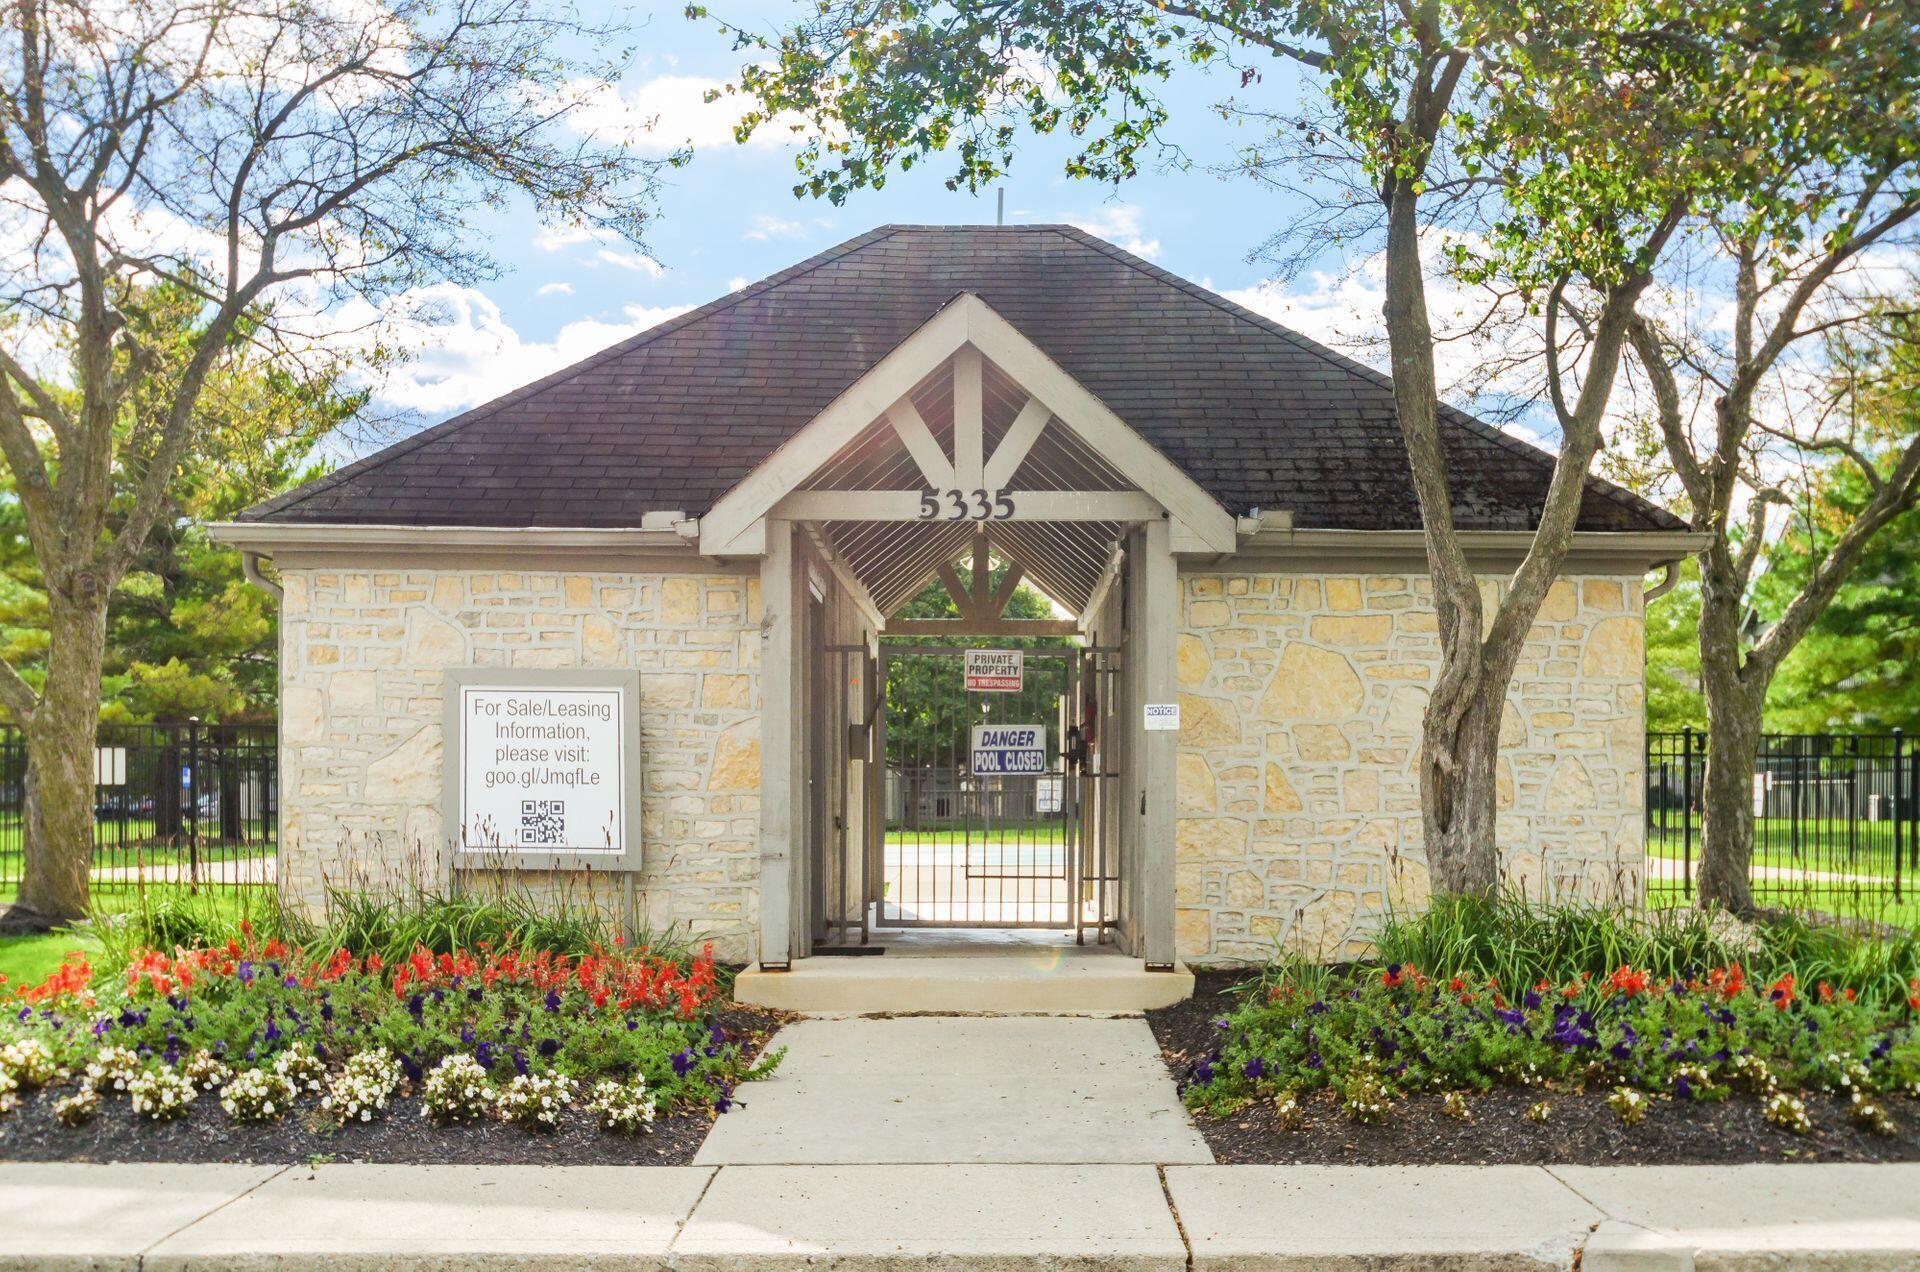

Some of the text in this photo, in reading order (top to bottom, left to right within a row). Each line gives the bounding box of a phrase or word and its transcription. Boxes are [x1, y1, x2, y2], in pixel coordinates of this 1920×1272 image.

[918, 488, 1016, 520] 5335
[974, 655, 1014, 664] PRIVATE
[969, 665, 1019, 675] PROPERTY
[474, 699, 611, 721] For Sale/Leasing
[1147, 707, 1177, 715] NOTICE
[495, 722, 590, 741] Information,
[981, 730, 1036, 746] DANGER
[495, 745, 590, 765] please visit:
[975, 751, 1044, 771] POOL CLOSED
[485, 767, 600, 788] goo.gl/JmqfLe
